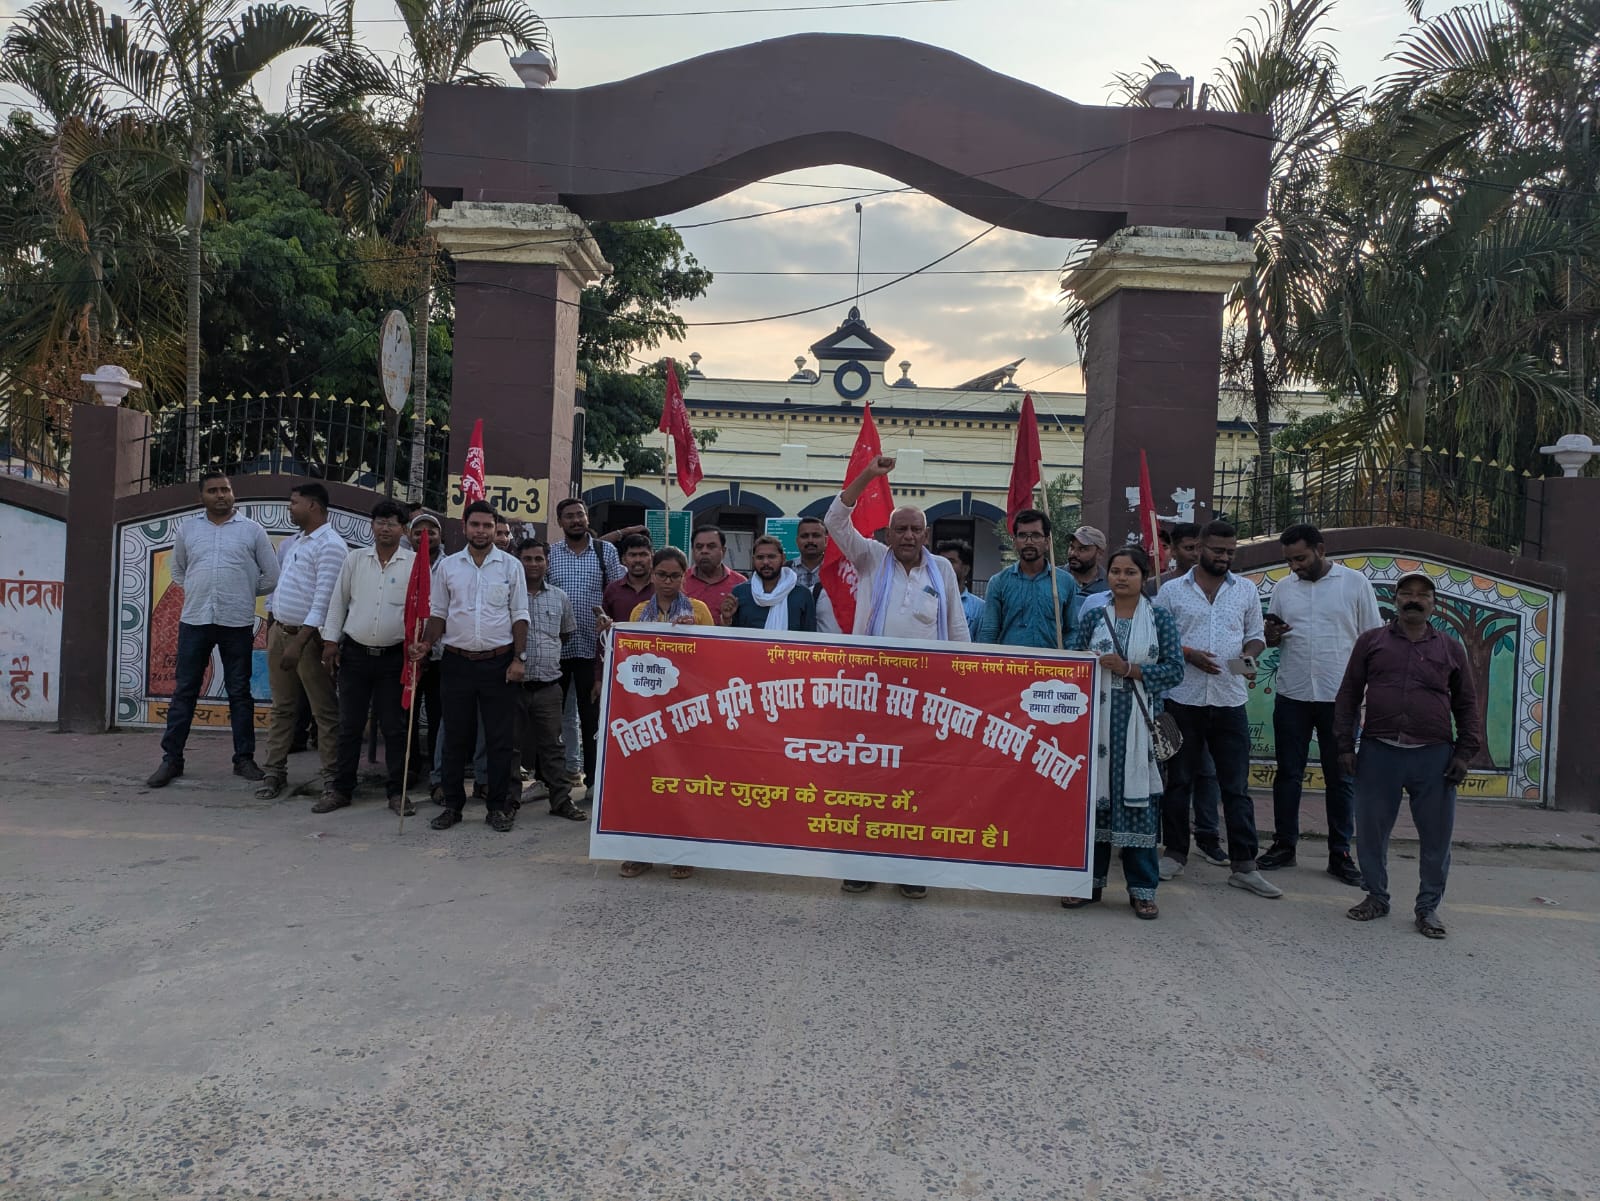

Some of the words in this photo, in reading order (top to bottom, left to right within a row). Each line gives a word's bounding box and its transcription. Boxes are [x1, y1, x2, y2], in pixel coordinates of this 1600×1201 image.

[0, 569, 64, 615] तंत्रता
[767, 645, 785, 664] भूमि
[787, 648, 811, 665] सुधार
[812, 648, 847, 666] कर्मचारी
[951, 657, 980, 676] संयुक्त
[981, 658, 1005, 674] संघर्ष
[1029, 703, 1050, 714] हमारा
[1053, 704, 1081, 716] हथियार
[1032, 690, 1054, 700] हमारी
[1056, 691, 1078, 701] एकता
[610, 710, 668, 758] बिहार
[666, 693, 713, 734] राज्य
[715, 677, 755, 731] भूमि
[757, 678, 806, 723] सुधार
[809, 669, 881, 713] कर्मचारी
[886, 677, 919, 720] संघ
[922, 687, 983, 741] संयुक्त
[982, 711, 1037, 762] संघर्ष
[1031, 736, 1087, 791] मोर्चा
[784, 733, 904, 769] दरभंगा
[651, 775, 681, 794] हर
[684, 774, 726, 797] जोर
[731, 782, 789, 809] जुलुम
[795, 782, 817, 805] के
[823, 789, 886, 810] टक्कर
[807, 813, 859, 837] संघर्ष
[866, 820, 926, 843] हमारा
[931, 825, 976, 846] नारा
